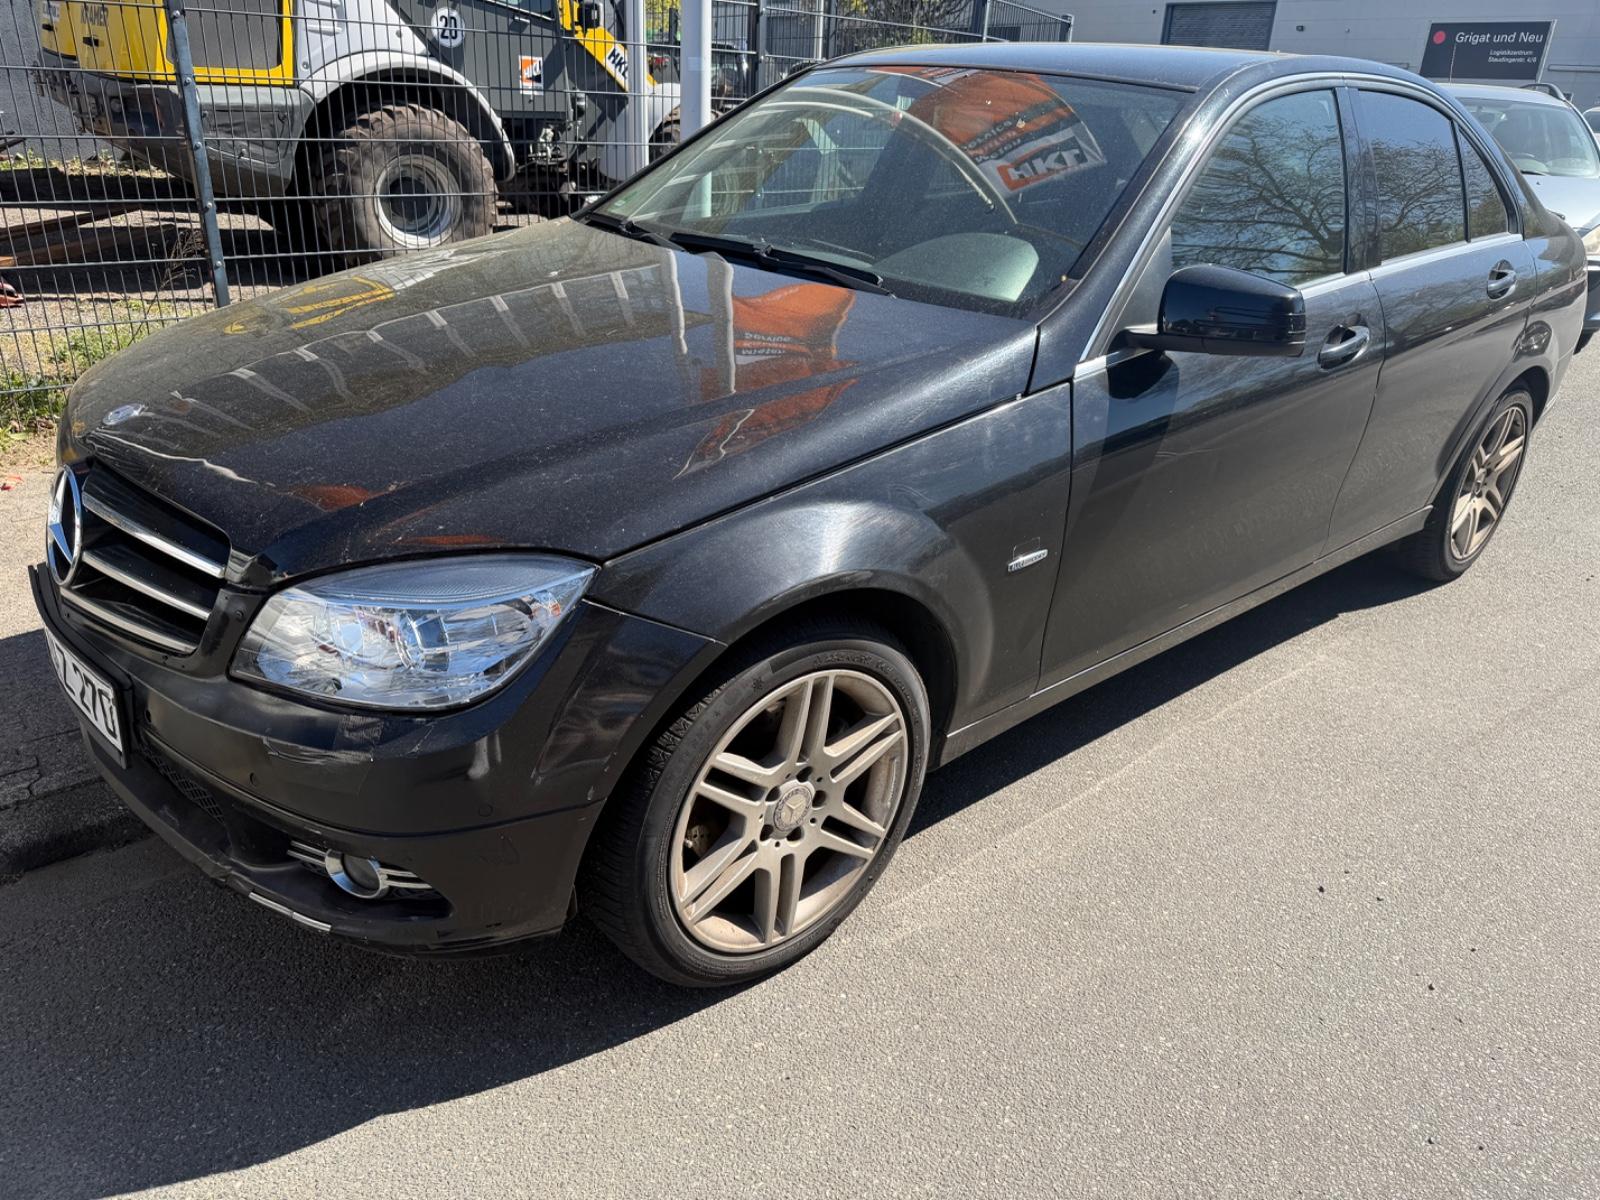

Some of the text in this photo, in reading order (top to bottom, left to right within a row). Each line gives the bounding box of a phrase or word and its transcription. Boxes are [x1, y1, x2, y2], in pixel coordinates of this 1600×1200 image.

[81, 5, 109, 26] KRAMER
[439, 15, 458, 40] 20
[1455, 31, 1544, 45] Grigat und Neu
[608, 47, 628, 80] HKL
[1489, 49, 1533, 57] Logistikzentrum
